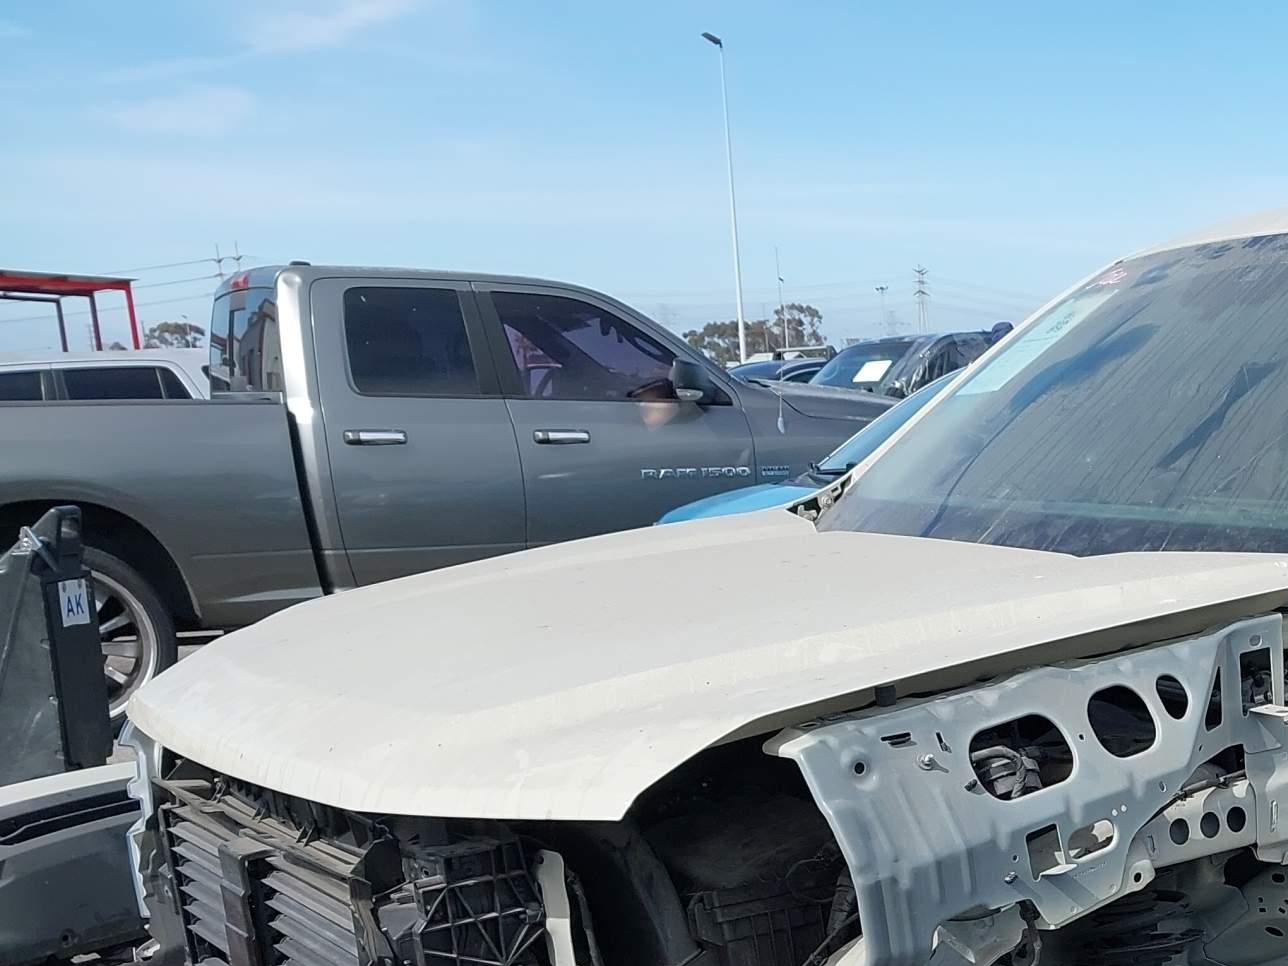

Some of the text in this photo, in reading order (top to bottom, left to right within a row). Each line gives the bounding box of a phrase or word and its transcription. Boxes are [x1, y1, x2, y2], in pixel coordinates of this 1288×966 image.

[639, 467, 697, 480] RAM
[701, 466, 751, 478] 1500
[66, 593, 85, 618] AK
